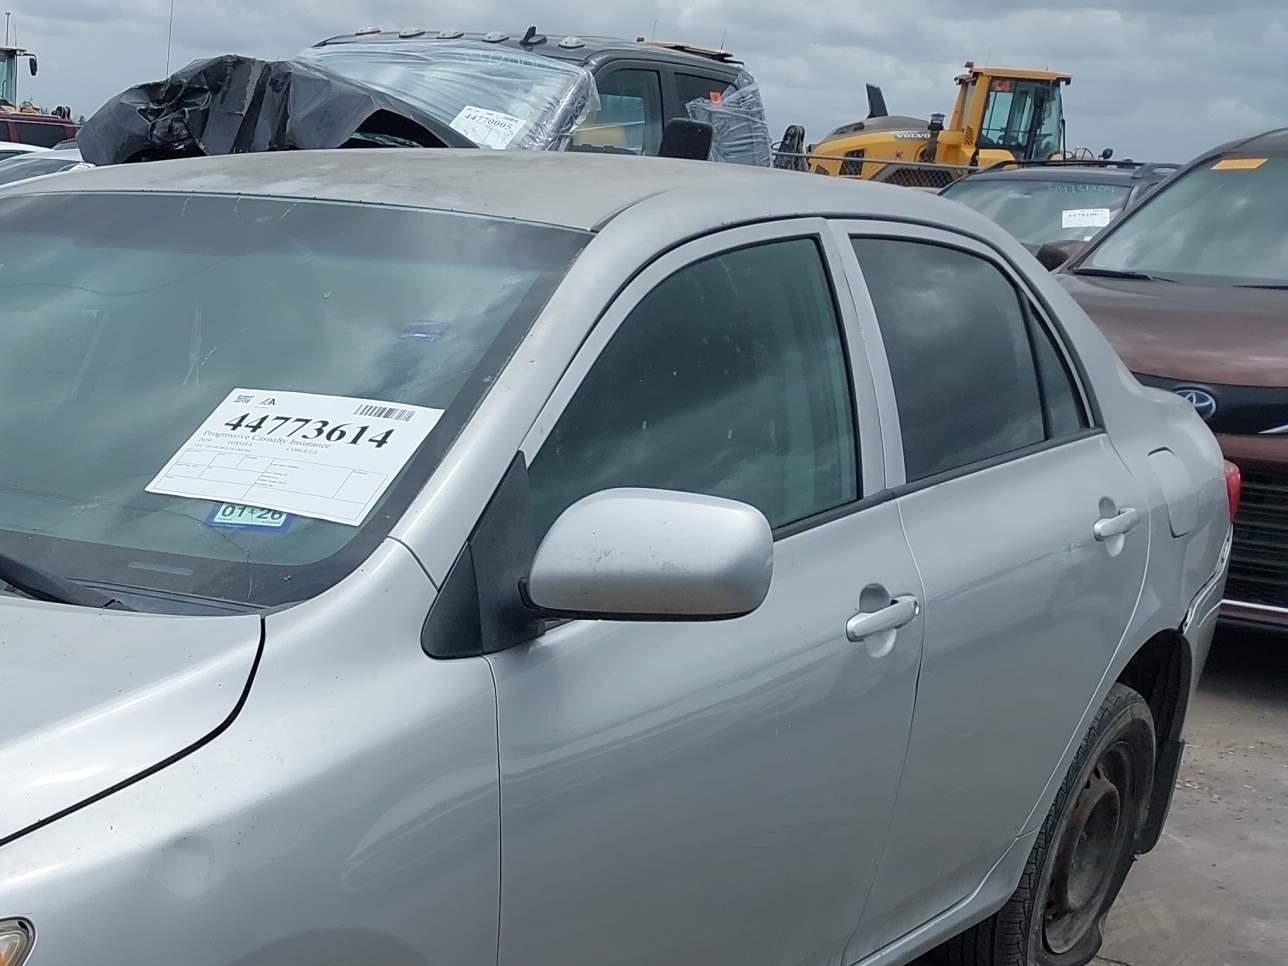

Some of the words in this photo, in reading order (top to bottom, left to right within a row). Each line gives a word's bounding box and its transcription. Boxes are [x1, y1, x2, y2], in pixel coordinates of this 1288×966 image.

[203, 430, 251, 441] Progressive
[252, 435, 287, 444] Casualty
[290, 439, 331, 449] Insurance
[224, 412, 395, 448] 44773614
